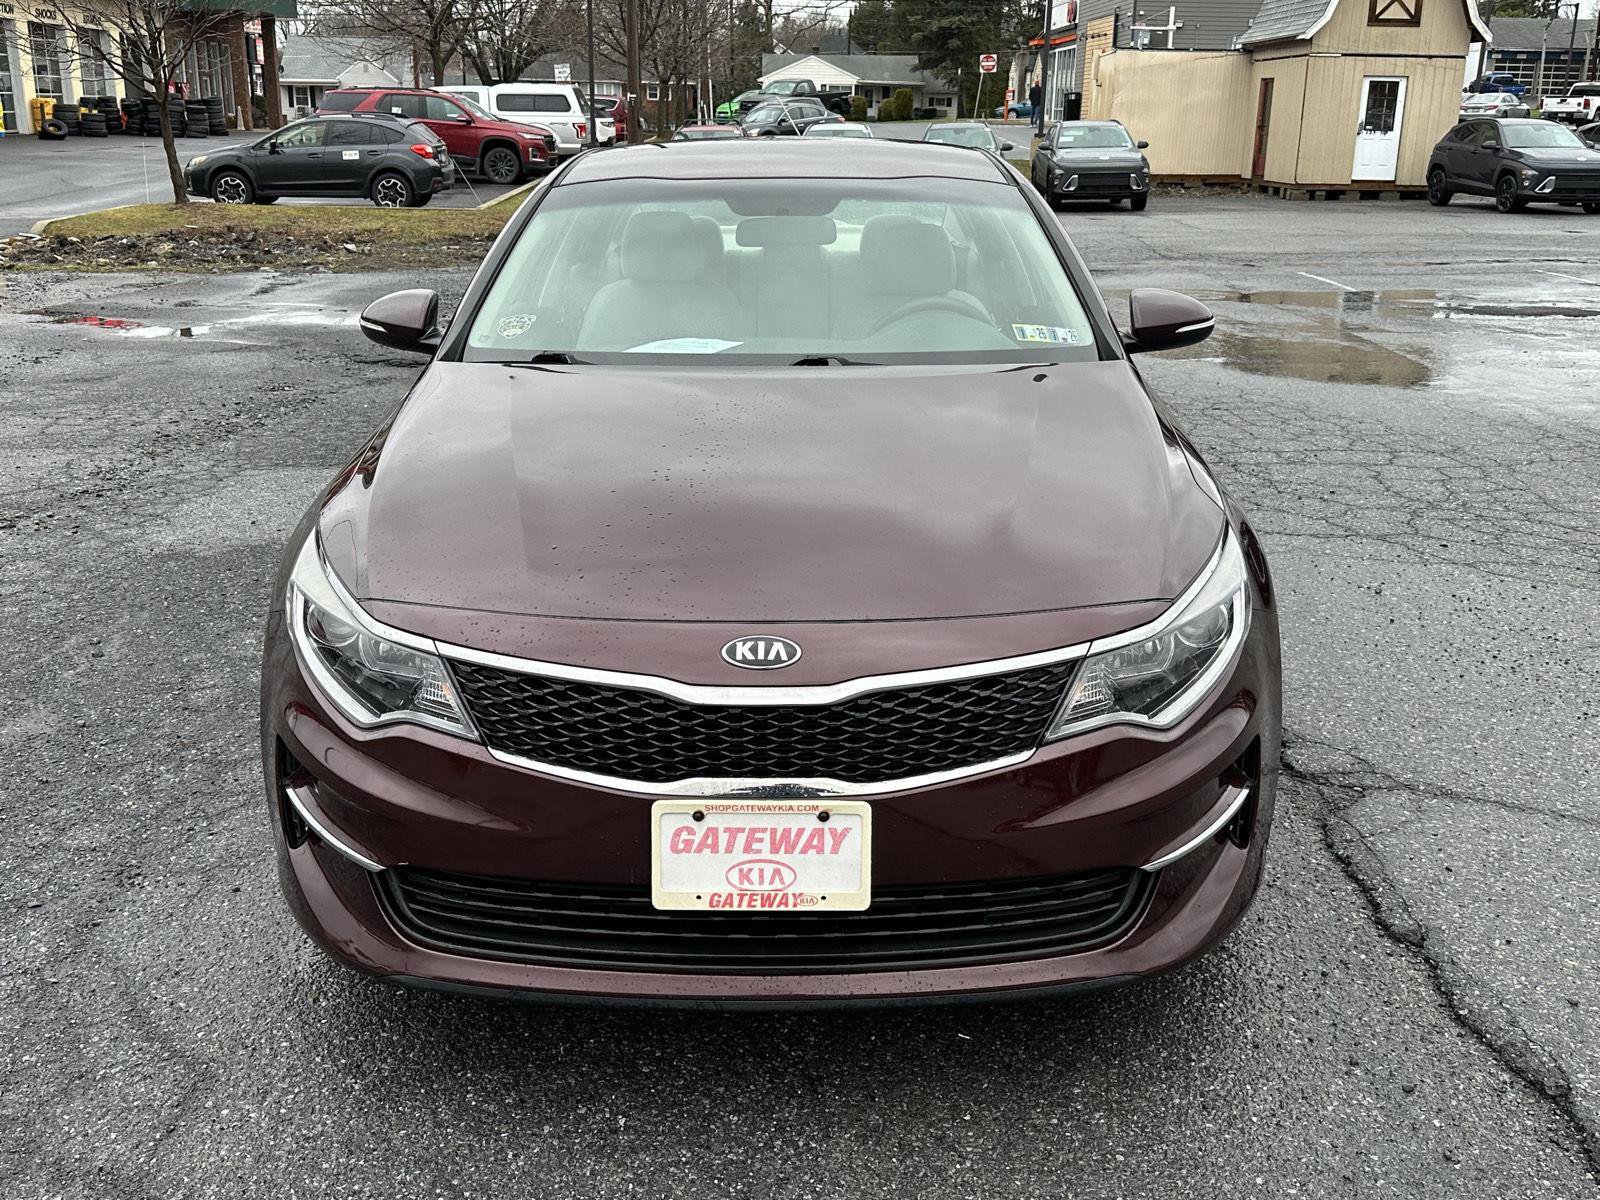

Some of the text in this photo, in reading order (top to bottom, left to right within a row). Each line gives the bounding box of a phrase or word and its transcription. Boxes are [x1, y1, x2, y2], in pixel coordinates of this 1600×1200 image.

[0, 3, 14, 14] TION
[35, 8, 57, 19] SHOCKS
[735, 641, 788, 660] KIA
[704, 804, 819, 812] SHOPGATEWAYKIA.COM
[670, 826, 852, 854] GATEWAY
[738, 867, 785, 885] KIA
[709, 893, 803, 908] GATEWAY
